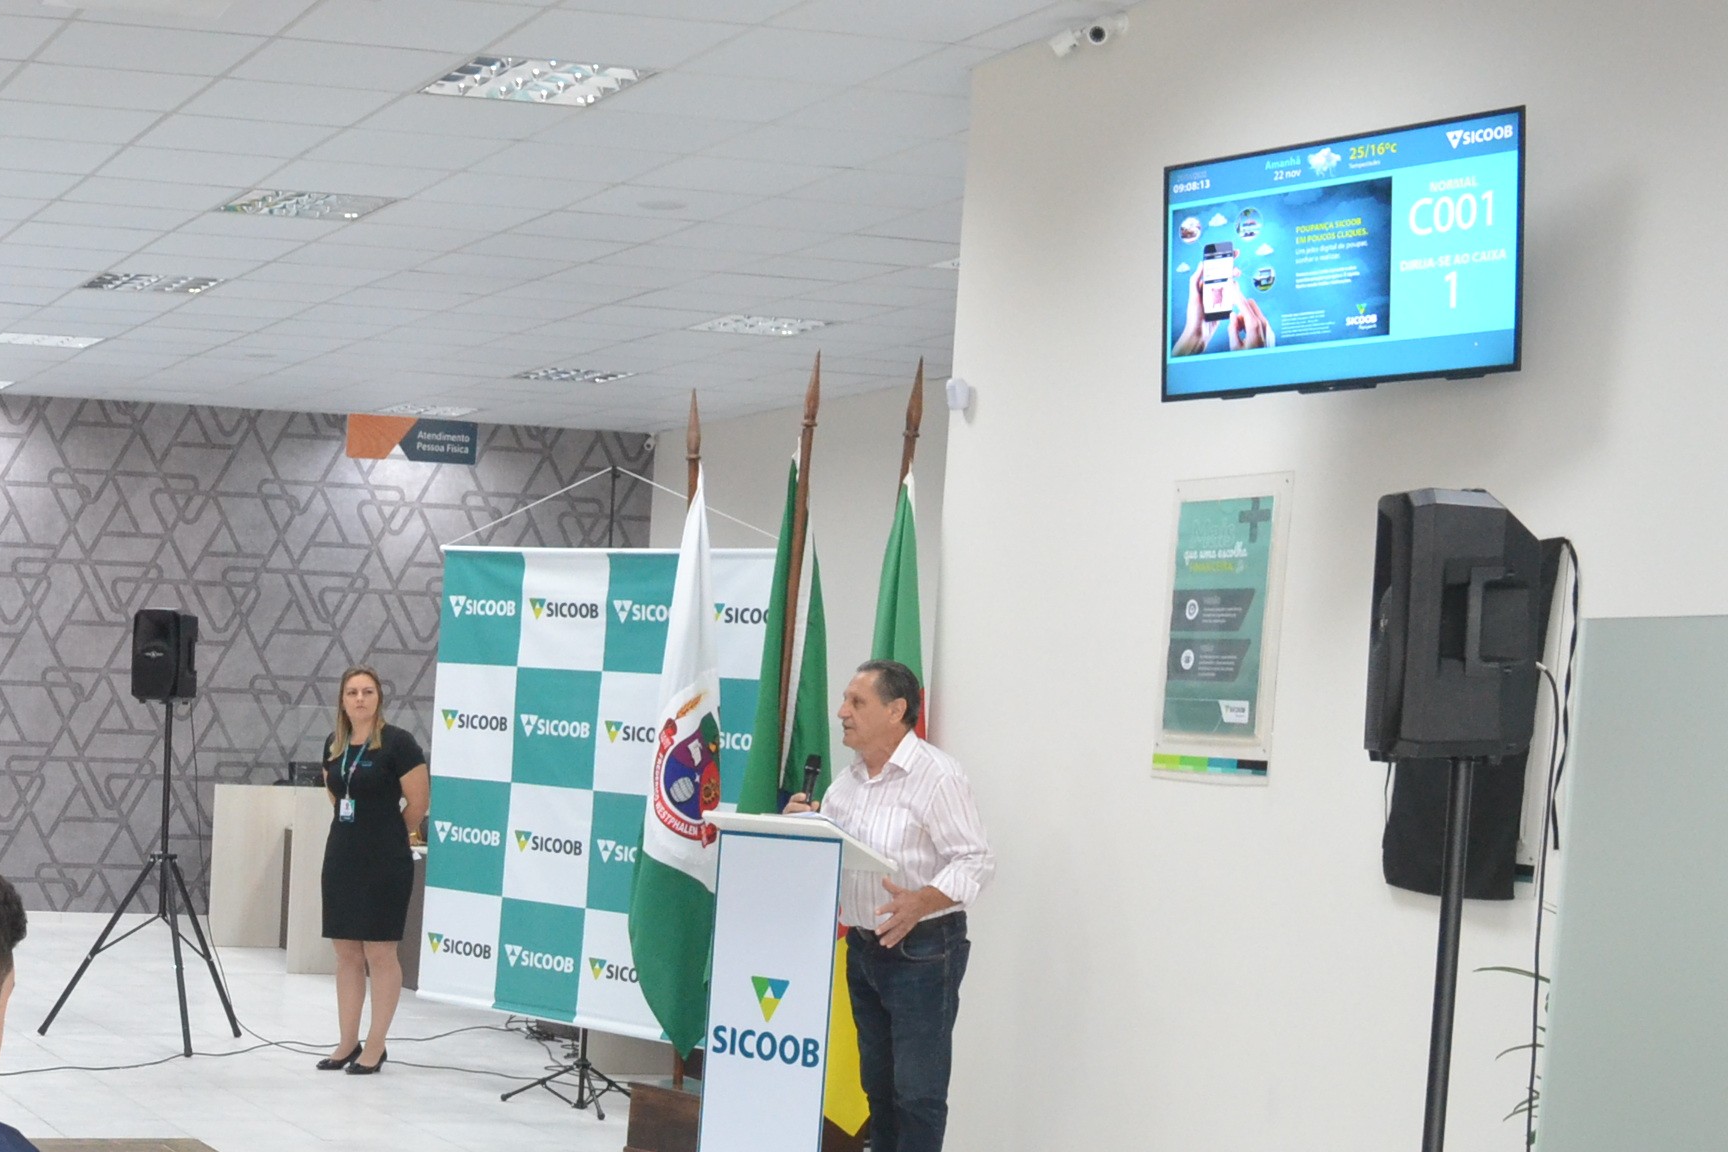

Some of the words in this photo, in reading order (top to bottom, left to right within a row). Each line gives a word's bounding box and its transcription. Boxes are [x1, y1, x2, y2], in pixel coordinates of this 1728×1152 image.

[1462, 125, 1513, 145] SICOOB
[1273, 170, 1285, 181] 22
[1286, 169, 1302, 178] nov
[1429, 176, 1477, 192] NORMAL
[1173, 179, 1211, 194] 09:08:13
[1409, 190, 1493, 236] C001
[1454, 253, 1470, 265] AO
[1472, 248, 1506, 262] CAIXA
[1444, 271, 1457, 309] 1
[417, 430, 470, 443] Atendimento
[416, 442, 445, 453] Pessoa
[446, 443, 469, 454] Física
[465, 599, 516, 616] SICOOB
[546, 602, 599, 619] SICOOB
[632, 604, 672, 622] SICO
[724, 607, 769, 624] SICO
[458, 713, 508, 732] SICOOB
[536, 720, 590, 738] SICOOB
[622, 725, 656, 743] SICO
[719, 731, 753, 750] SICO
[450, 826, 501, 847] SICOOB
[531, 835, 583, 856] SICOOB
[615, 845, 638, 863] SIC
[442, 938, 492, 960] SICOOB
[521, 950, 574, 973] SICOOB
[606, 964, 639, 983] SICO
[712, 1025, 820, 1068] SICOOB
